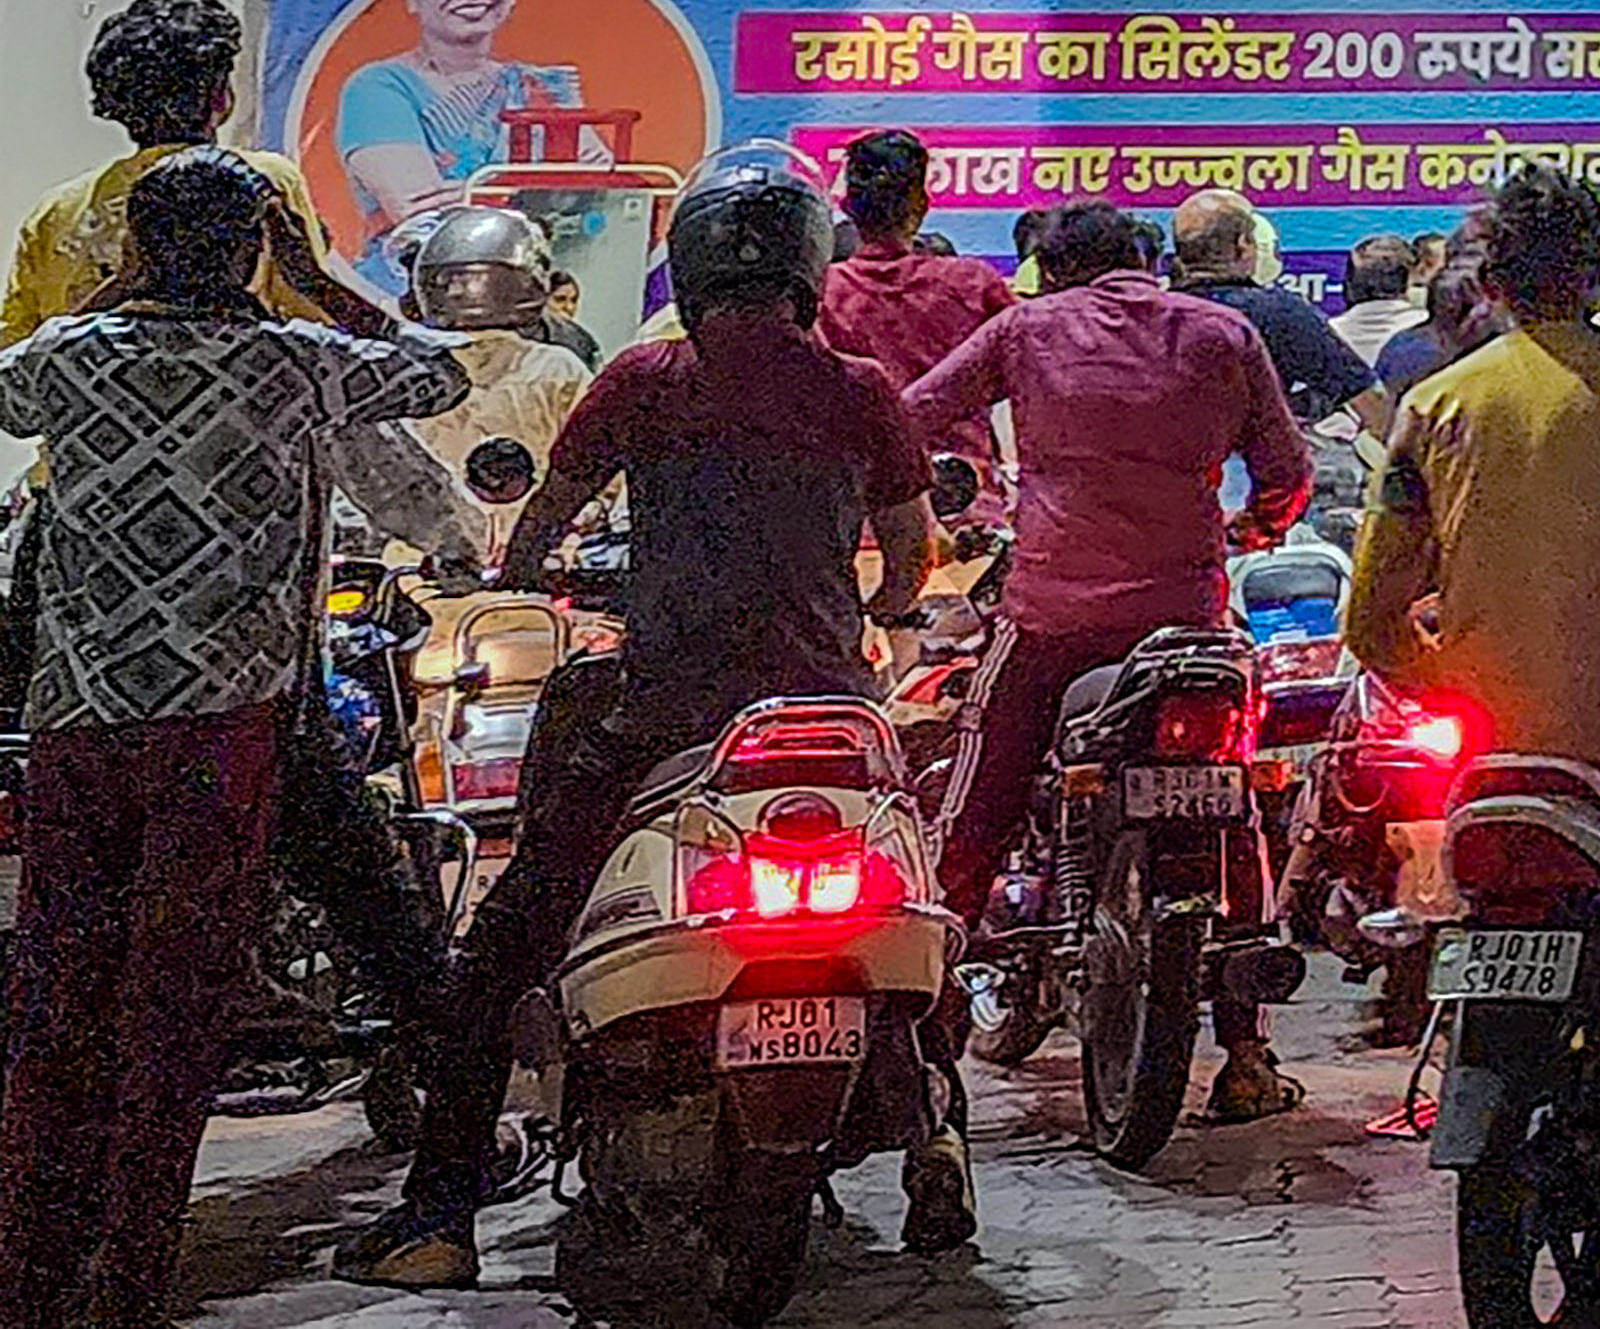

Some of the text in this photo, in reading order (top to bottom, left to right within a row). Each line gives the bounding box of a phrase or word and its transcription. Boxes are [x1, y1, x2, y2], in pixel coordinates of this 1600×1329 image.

[792, 16, 931, 86] रसोई
[933, 12, 1029, 81] गैस
[1036, 31, 1111, 81] का
[1119, 15, 1295, 81] सिलेंडर
[1303, 31, 1403, 79] 200
[1031, 147, 1115, 194] नए
[1321, 126, 1410, 191] गैस
[1469, 933, 1564, 964] RJ01H
[1463, 964, 1556, 995] S9478
[757, 998, 836, 1029] RJ01
